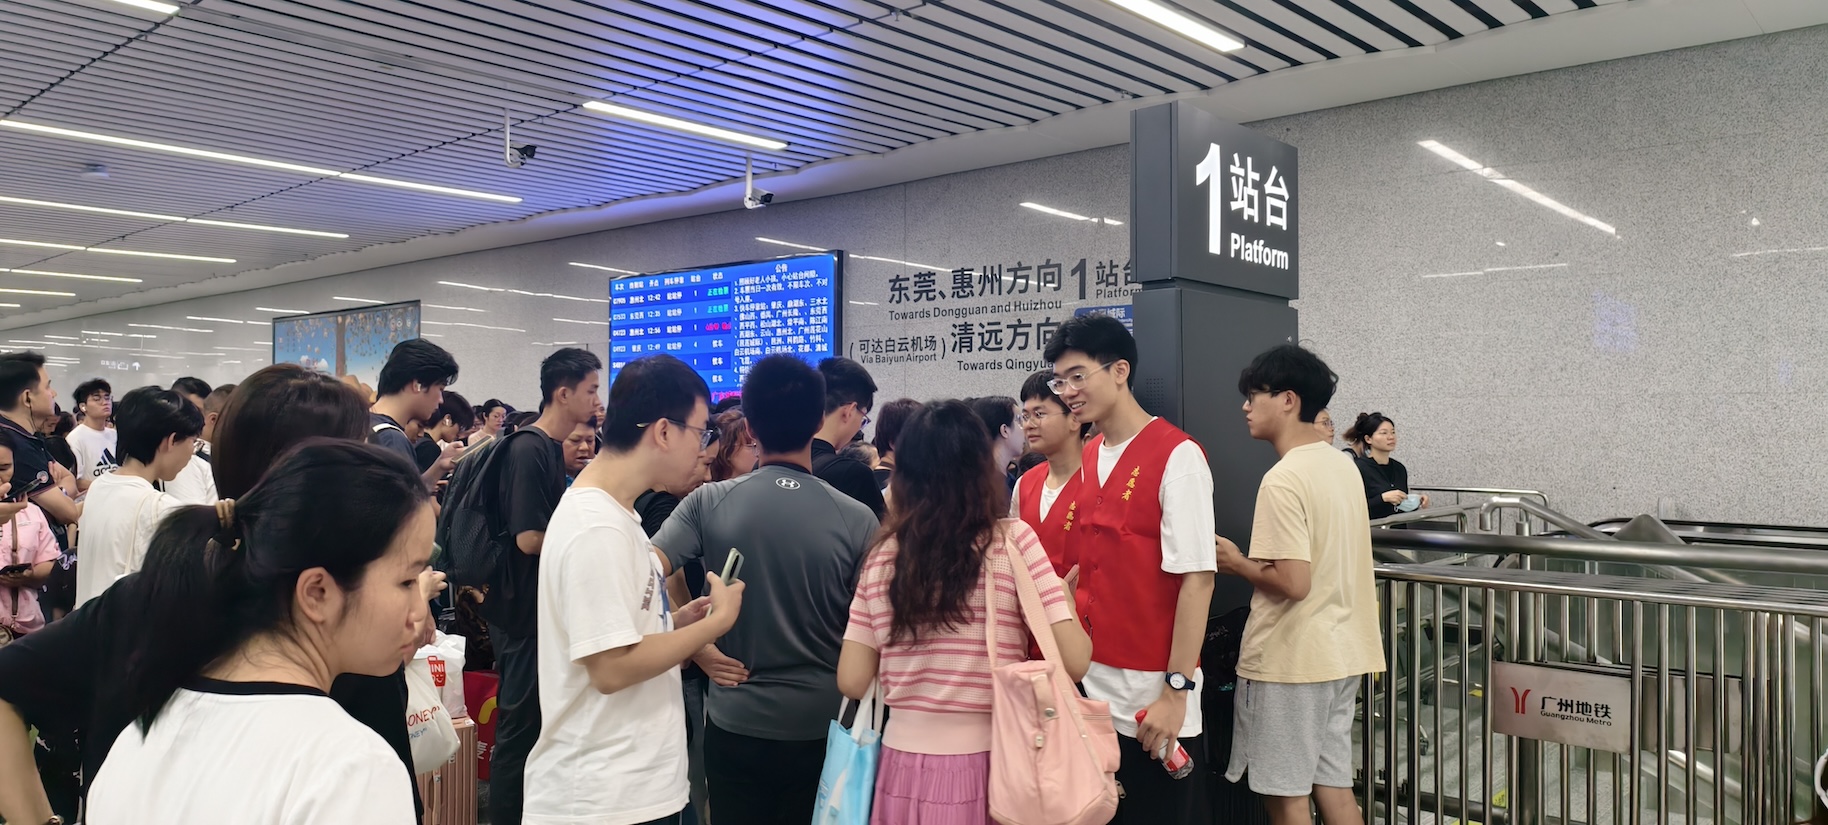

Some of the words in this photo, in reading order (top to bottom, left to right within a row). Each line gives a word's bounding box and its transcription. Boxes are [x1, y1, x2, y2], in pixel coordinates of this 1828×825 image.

[1195, 142, 1221, 255] 1
[1230, 152, 1290, 231] 站台
[1230, 232, 1289, 270] Platform
[889, 259, 1062, 304] 东莞、惠州方向
[1071, 258, 1086, 300] 1
[889, 308, 931, 321] Towards
[933, 305, 988, 319] Dongguan
[990, 301, 1011, 314] and
[1014, 299, 1062, 312] Huizhou
[861, 355, 873, 364] Via
[875, 354, 905, 365] Baiyun
[906, 353, 937, 363] Airport
[957, 359, 1003, 371] Towards
[1005, 358, 1054, 371] Qingyua
[1122, 465, 1140, 501] 志愿者
[1063, 500, 1076, 531] 志愿者
[1540, 710, 1585, 723] Guangzhou
[1586, 717, 1612, 727] Metro
[1541, 696, 1612, 719] 广州地铁
